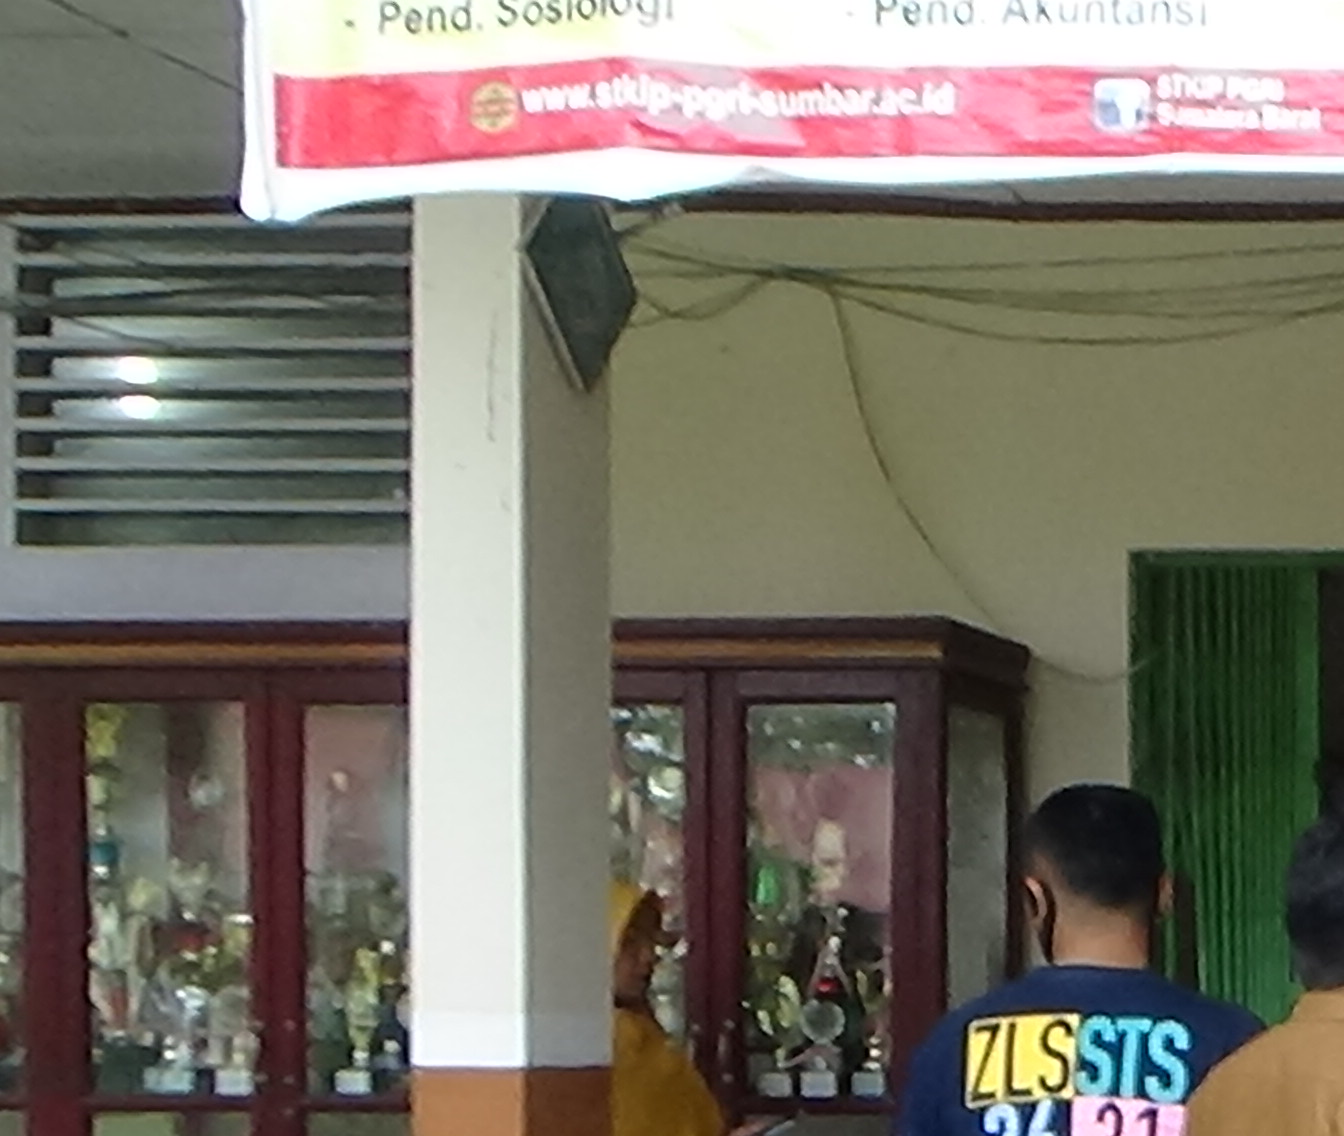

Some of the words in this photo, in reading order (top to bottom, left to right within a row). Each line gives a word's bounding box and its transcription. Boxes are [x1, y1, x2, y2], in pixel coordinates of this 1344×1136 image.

[377, 0, 485, 34] Pend.
[875, 0, 985, 28] Pend.
[1002, 0, 1208, 27] Akuntansi
[521, 74, 955, 121] www.stkip-pgri-sumbar.ac.id
[969, 1017, 1073, 1101] ZLS
[1076, 1014, 1193, 1105] STS
